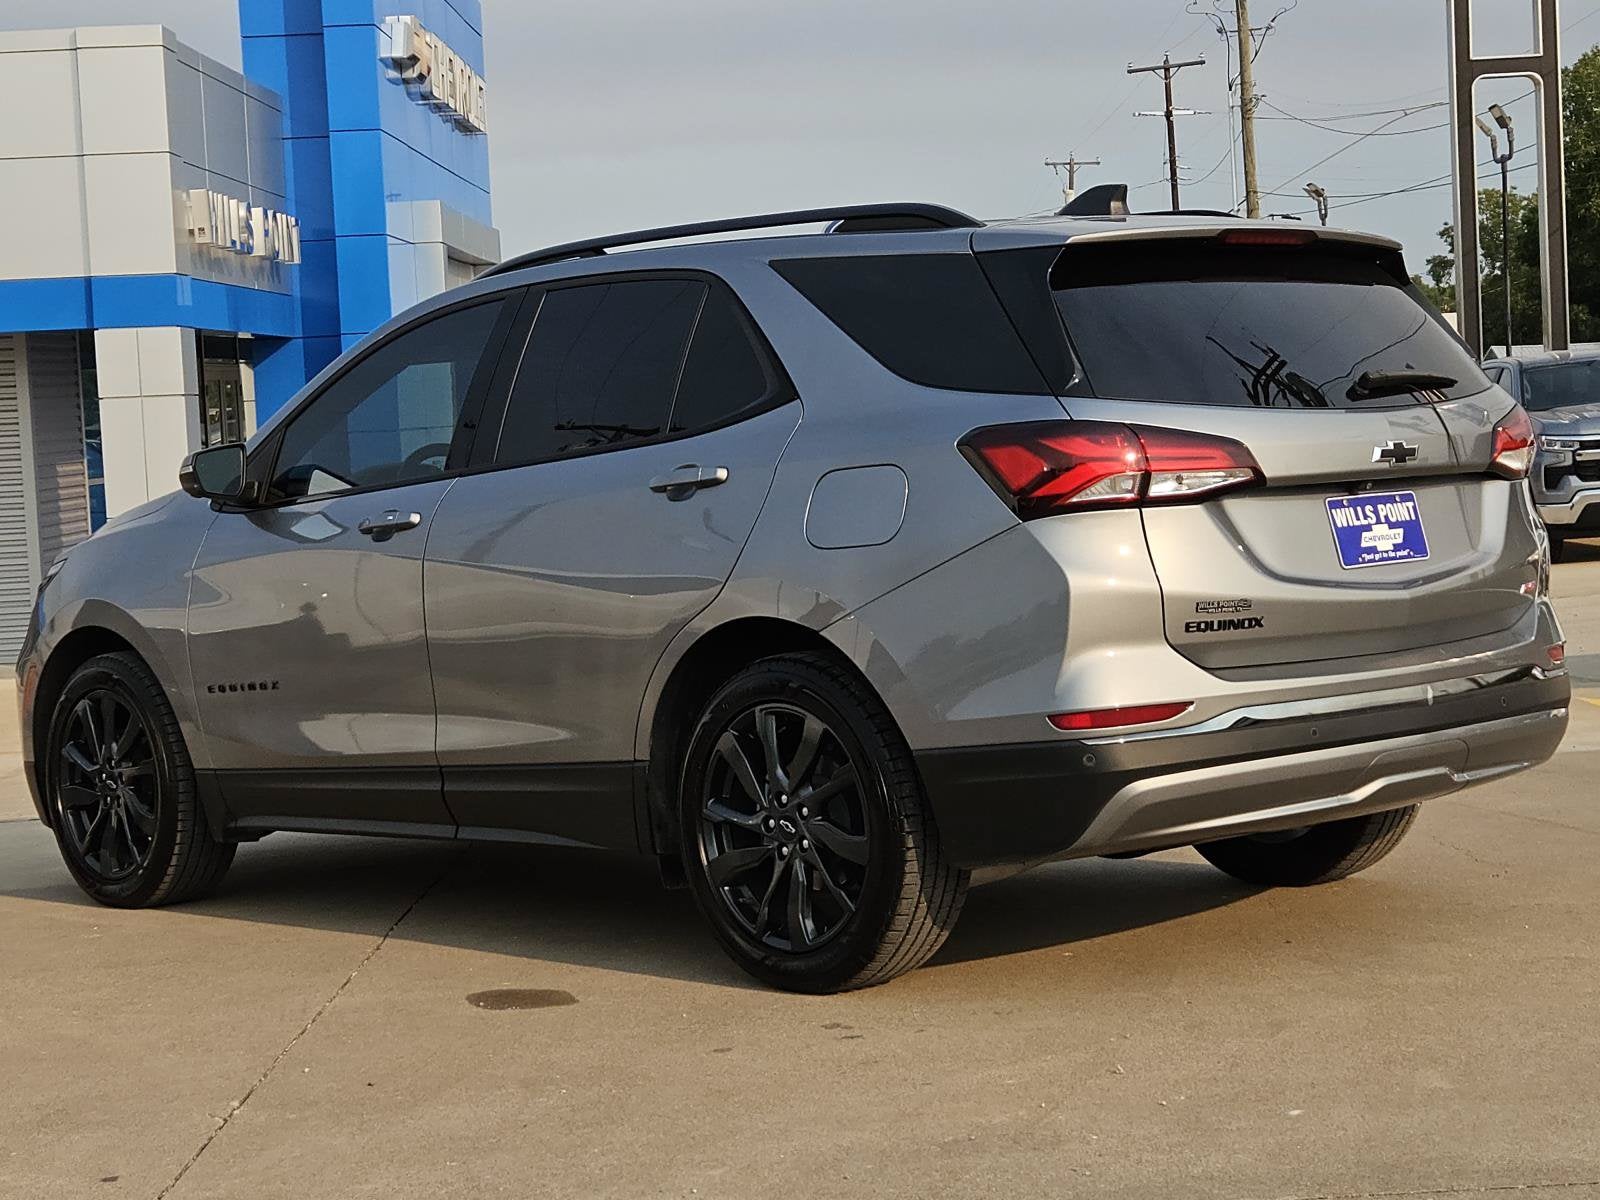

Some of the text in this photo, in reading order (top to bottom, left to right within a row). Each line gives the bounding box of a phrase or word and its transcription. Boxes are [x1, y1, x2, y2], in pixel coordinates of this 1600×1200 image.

[1331, 501, 1416, 528] WILLS POINT
[1363, 532, 1401, 543] CHEVROLET
[1199, 600, 1239, 608] WILLS POINT
[1184, 616, 1264, 634] EQUINOX
[207, 681, 280, 694] EQUINOX
